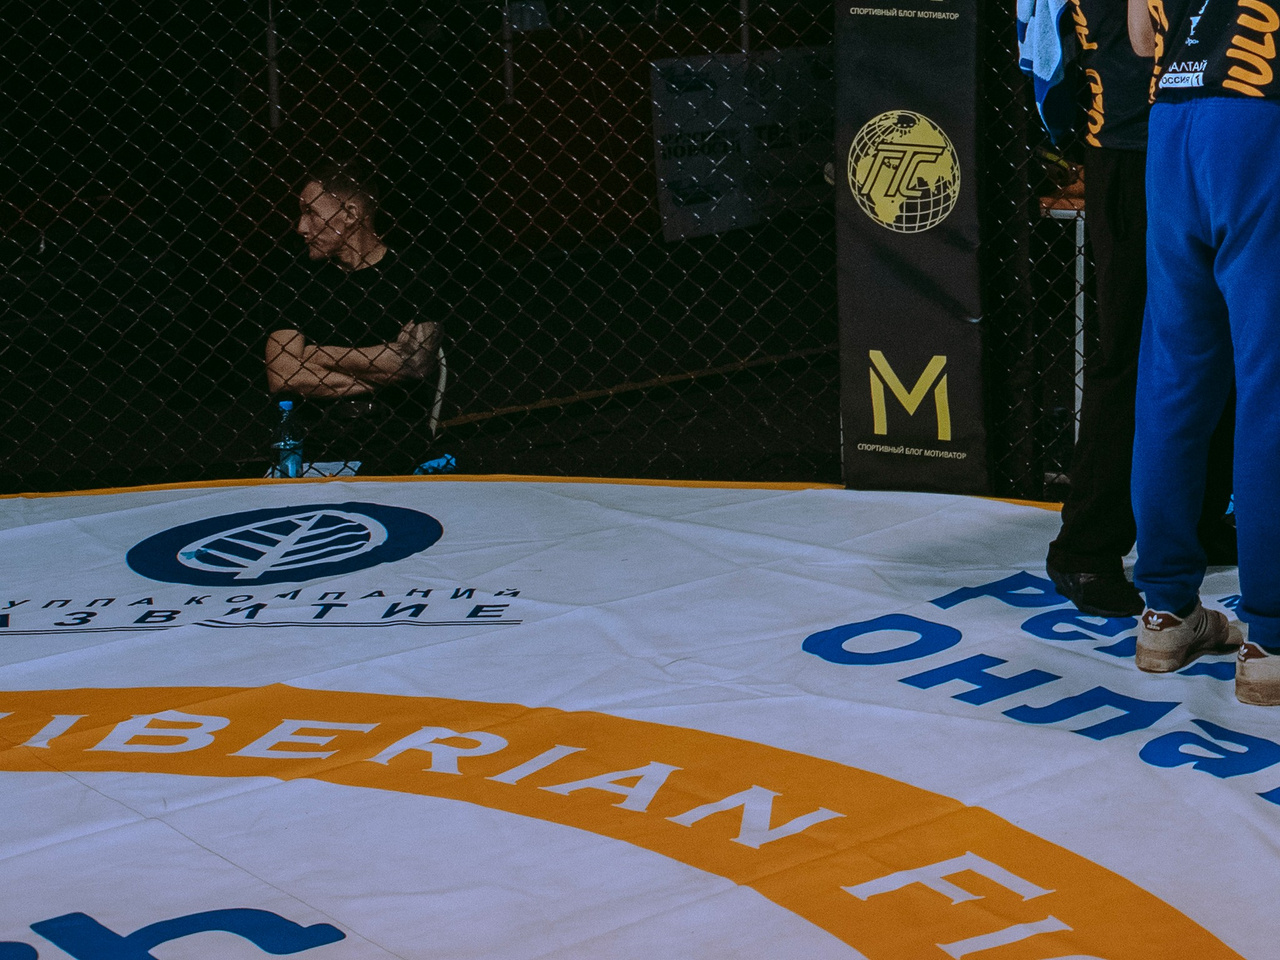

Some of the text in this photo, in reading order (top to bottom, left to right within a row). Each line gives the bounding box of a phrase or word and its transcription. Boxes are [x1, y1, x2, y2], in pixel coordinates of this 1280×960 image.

[850, 6, 960, 20] СПОРТИВНЫЙ БЛОГ МОТИВАТОР
[857, 443, 967, 460] СПОРТИВНЫЙ БЛОГ МОТИВАТОР
[0, 710, 847, 849] IBERIAN
